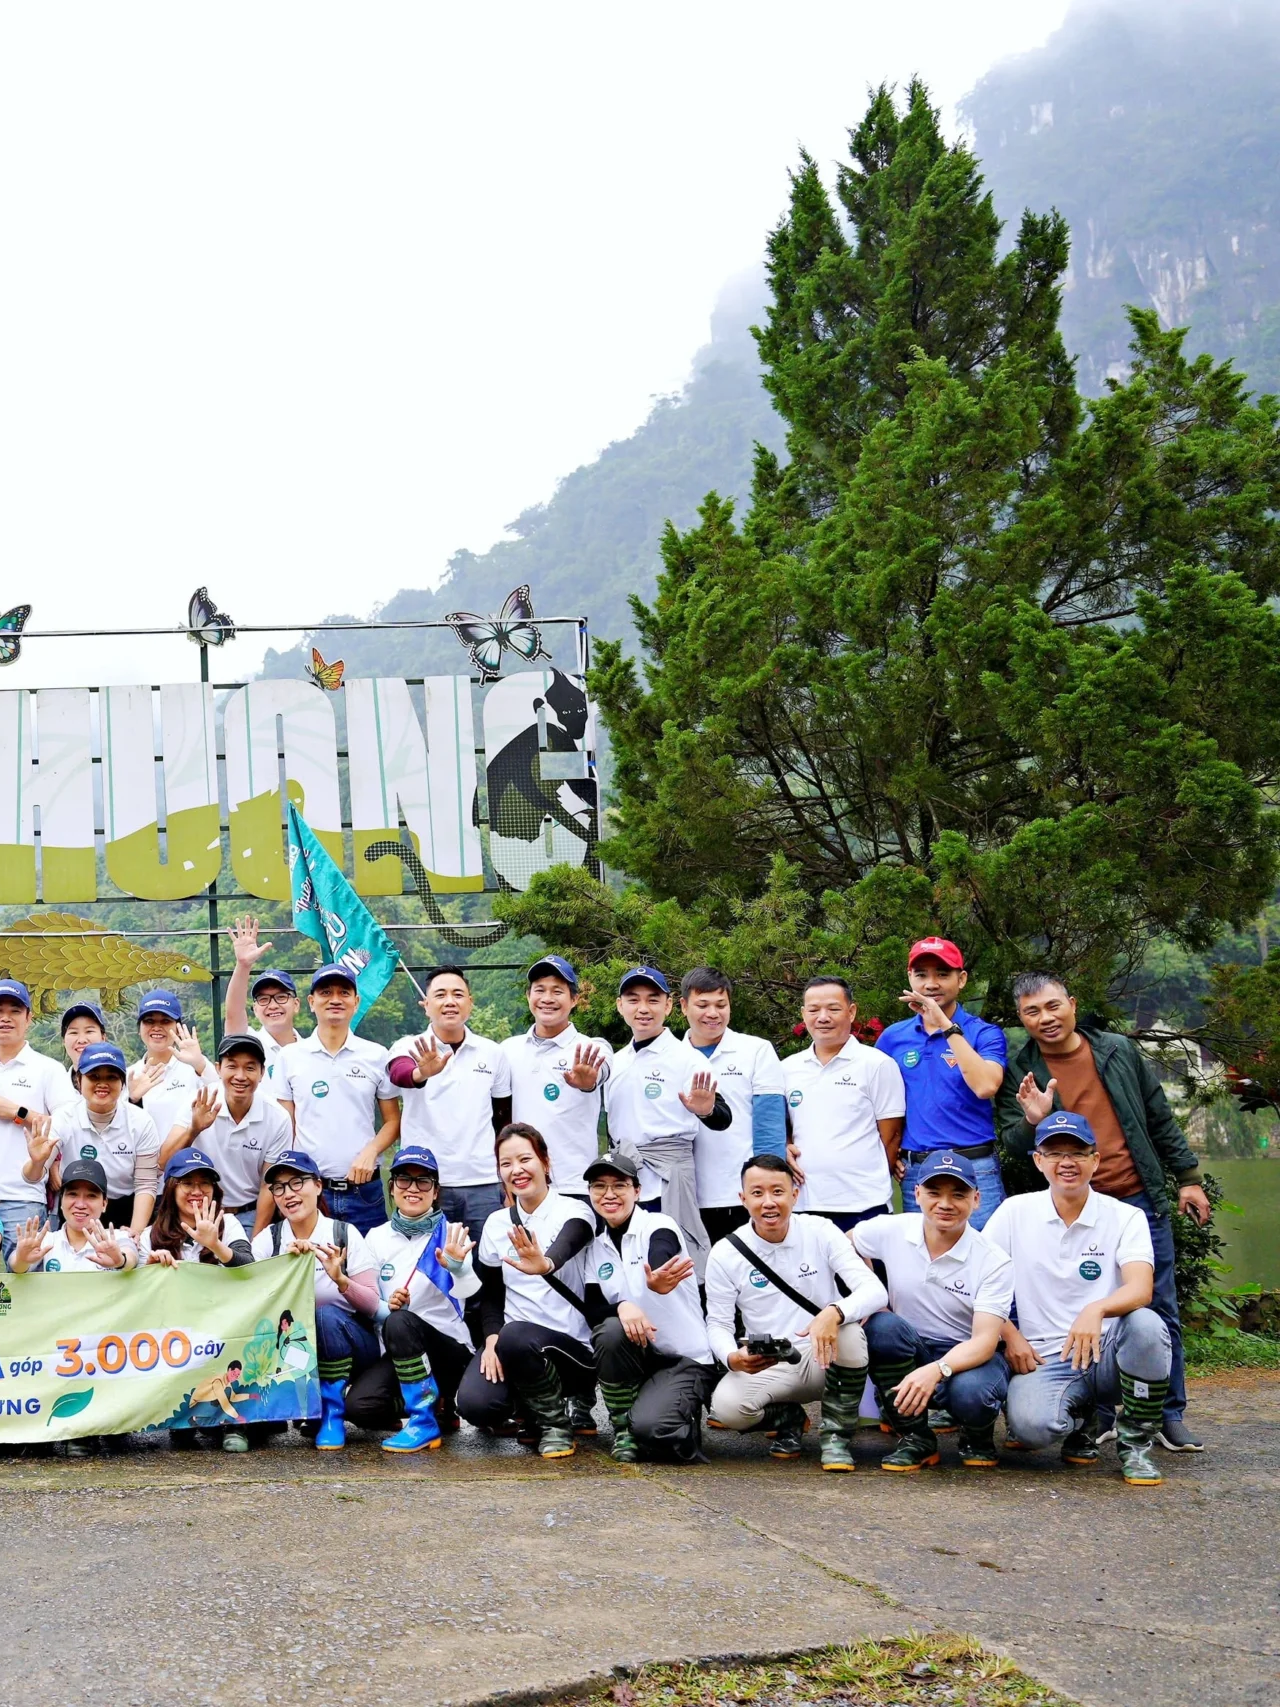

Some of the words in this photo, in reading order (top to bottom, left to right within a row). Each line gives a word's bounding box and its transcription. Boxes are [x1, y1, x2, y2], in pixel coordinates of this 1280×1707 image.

[9, 1358, 43, 1378] góp
[54, 1330, 195, 1378] 3.000
[193, 1340, 226, 1359] cây
